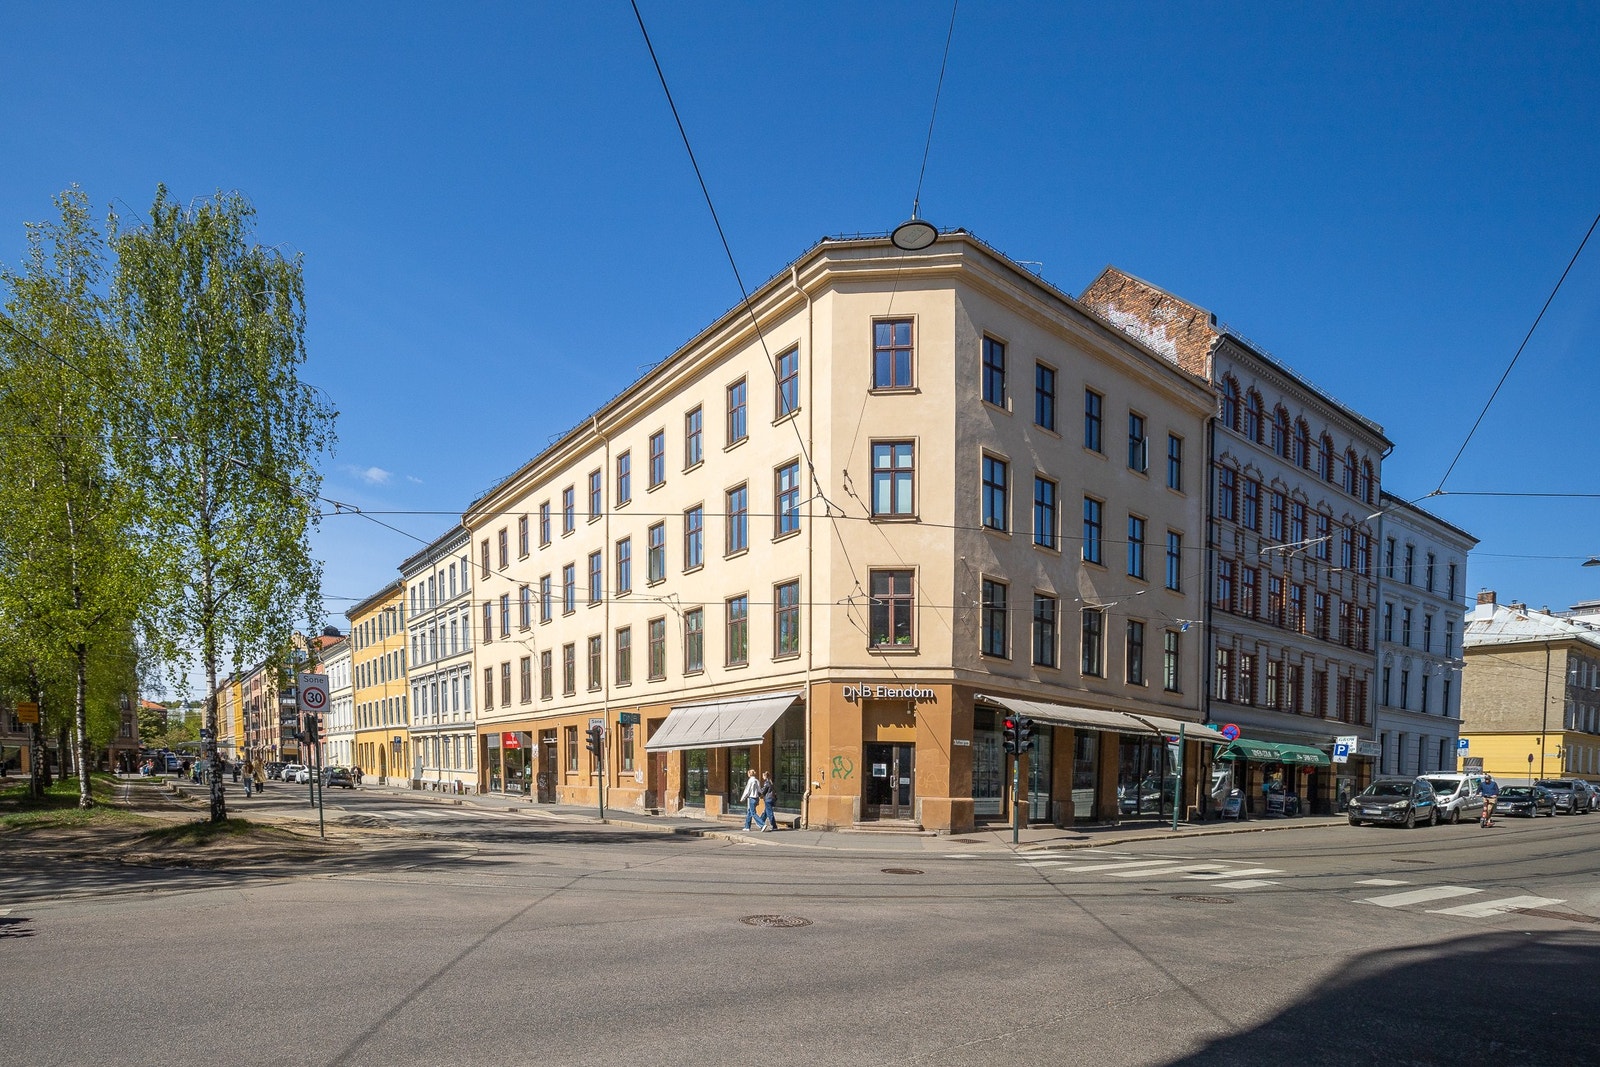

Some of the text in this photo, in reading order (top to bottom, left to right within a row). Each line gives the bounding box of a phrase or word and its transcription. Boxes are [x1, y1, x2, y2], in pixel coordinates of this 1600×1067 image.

[303, 675, 324, 684] Sone
[842, 681, 934, 701] DNB Eiendom
[307, 692, 323, 703] 30
[622, 713, 639, 723] DNB
[1459, 740, 1467, 748] P
[1337, 745, 1346, 755] P
